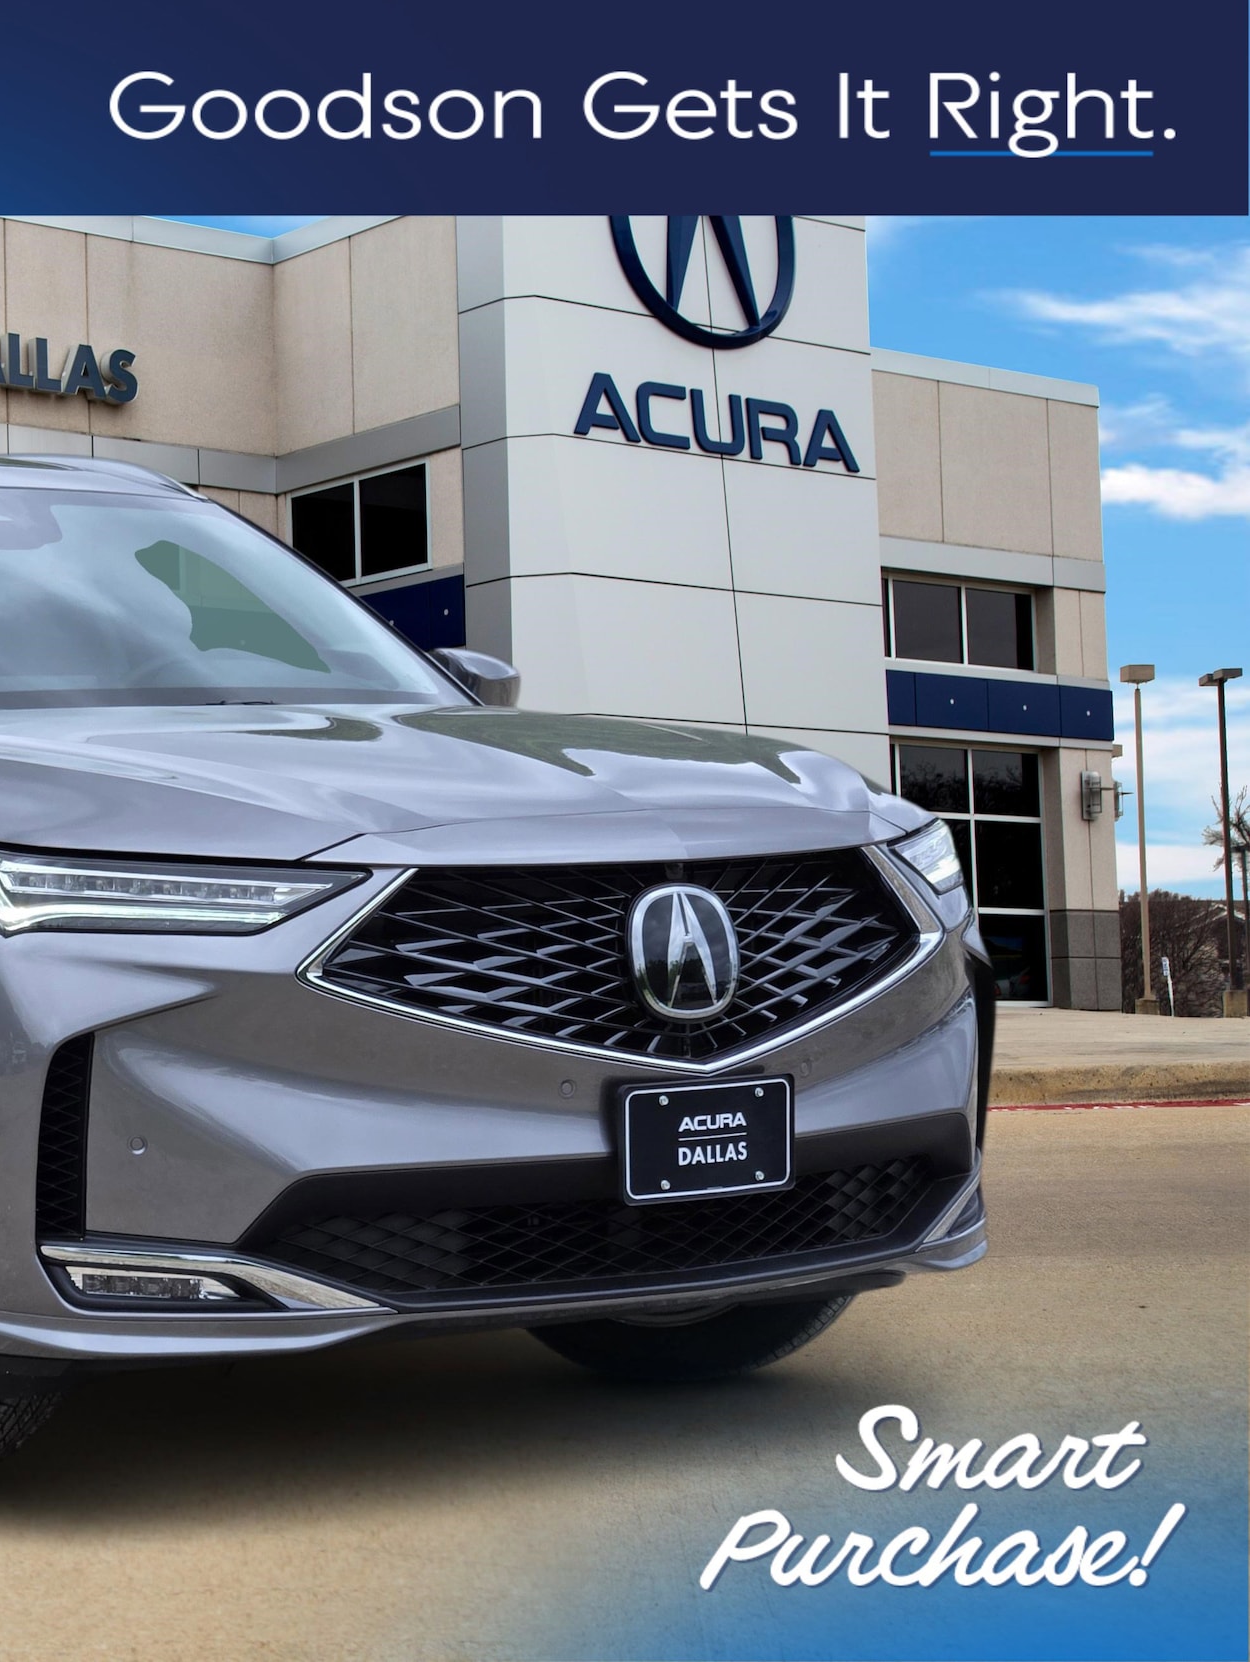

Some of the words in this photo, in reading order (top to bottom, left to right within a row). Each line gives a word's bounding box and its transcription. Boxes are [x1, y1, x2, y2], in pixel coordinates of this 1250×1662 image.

[573, 372, 860, 473] ACURA
[678, 1112, 747, 1133] ACURA
[678, 1141, 748, 1166] DALLAS
